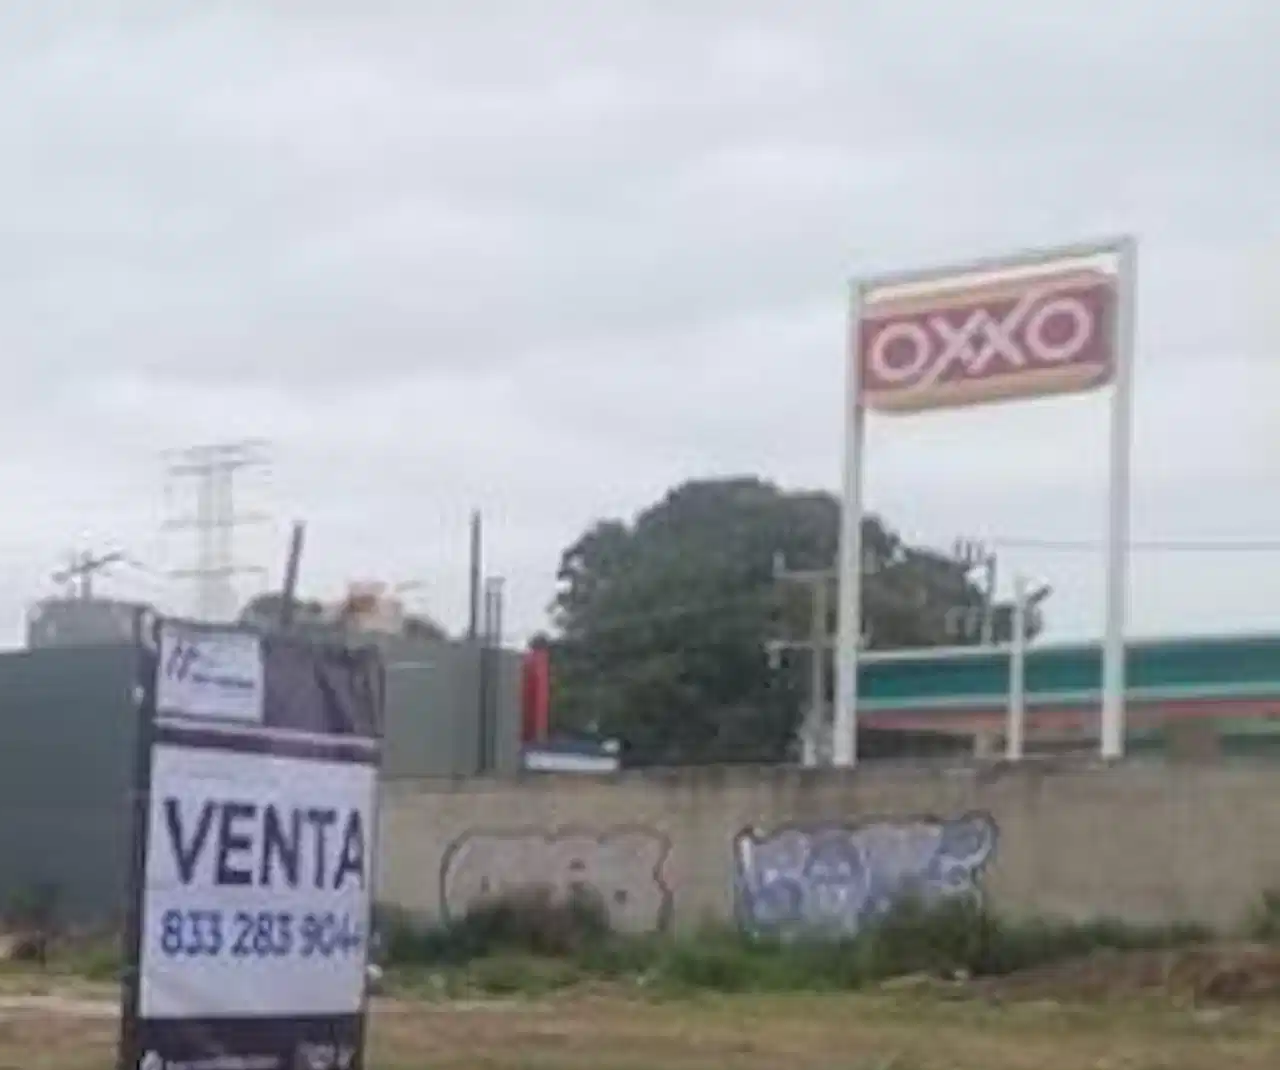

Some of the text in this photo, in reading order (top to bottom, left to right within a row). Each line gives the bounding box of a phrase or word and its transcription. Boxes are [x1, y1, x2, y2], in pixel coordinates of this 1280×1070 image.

[871, 290, 1095, 391] OXXO
[163, 796, 365, 891] VENTA
[161, 908, 223, 958] 833
[230, 910, 293, 958] 283
